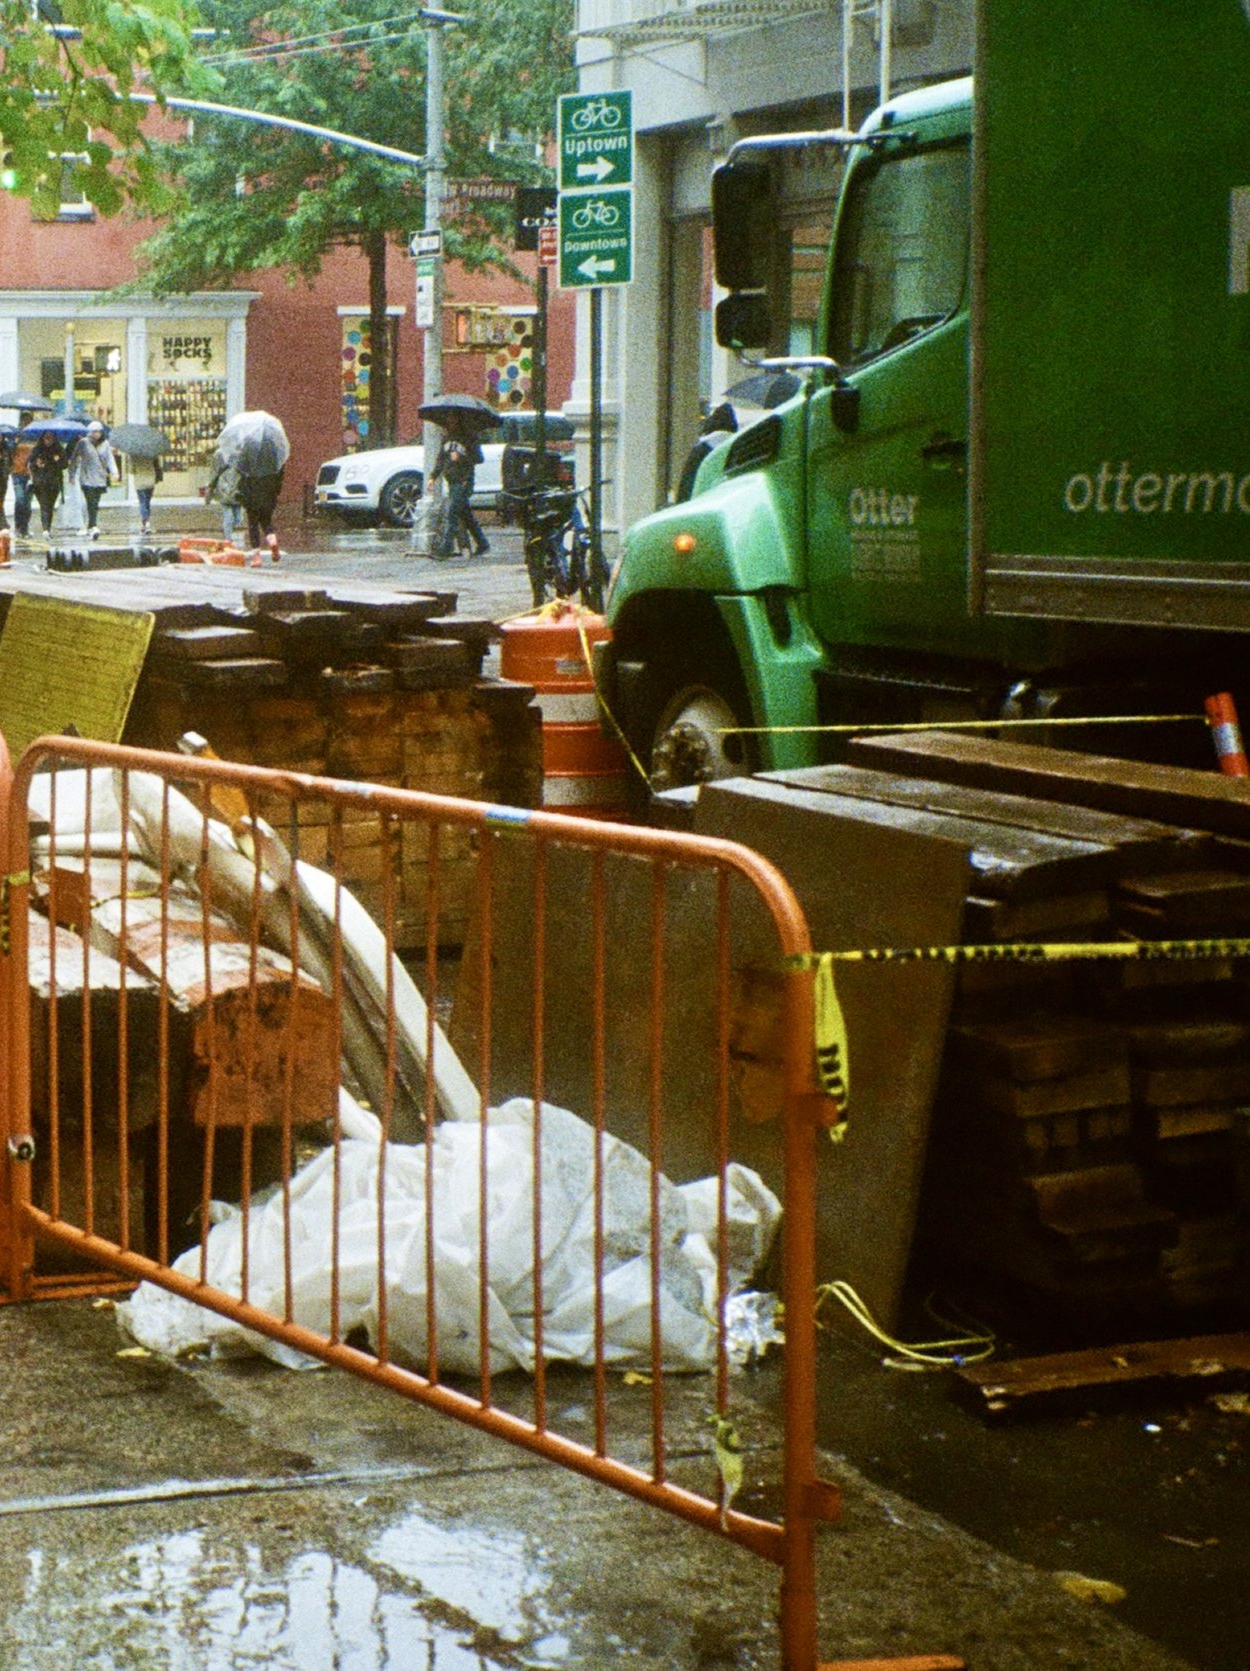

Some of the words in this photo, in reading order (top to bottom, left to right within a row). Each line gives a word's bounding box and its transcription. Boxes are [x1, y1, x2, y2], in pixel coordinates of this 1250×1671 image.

[565, 135, 628, 157] Uptown
[564, 237, 628, 253] Downtown
[162, 336, 212, 348] HAPPY
[163, 347, 212, 360] SOCKS
[848, 487, 919, 525] Otter
